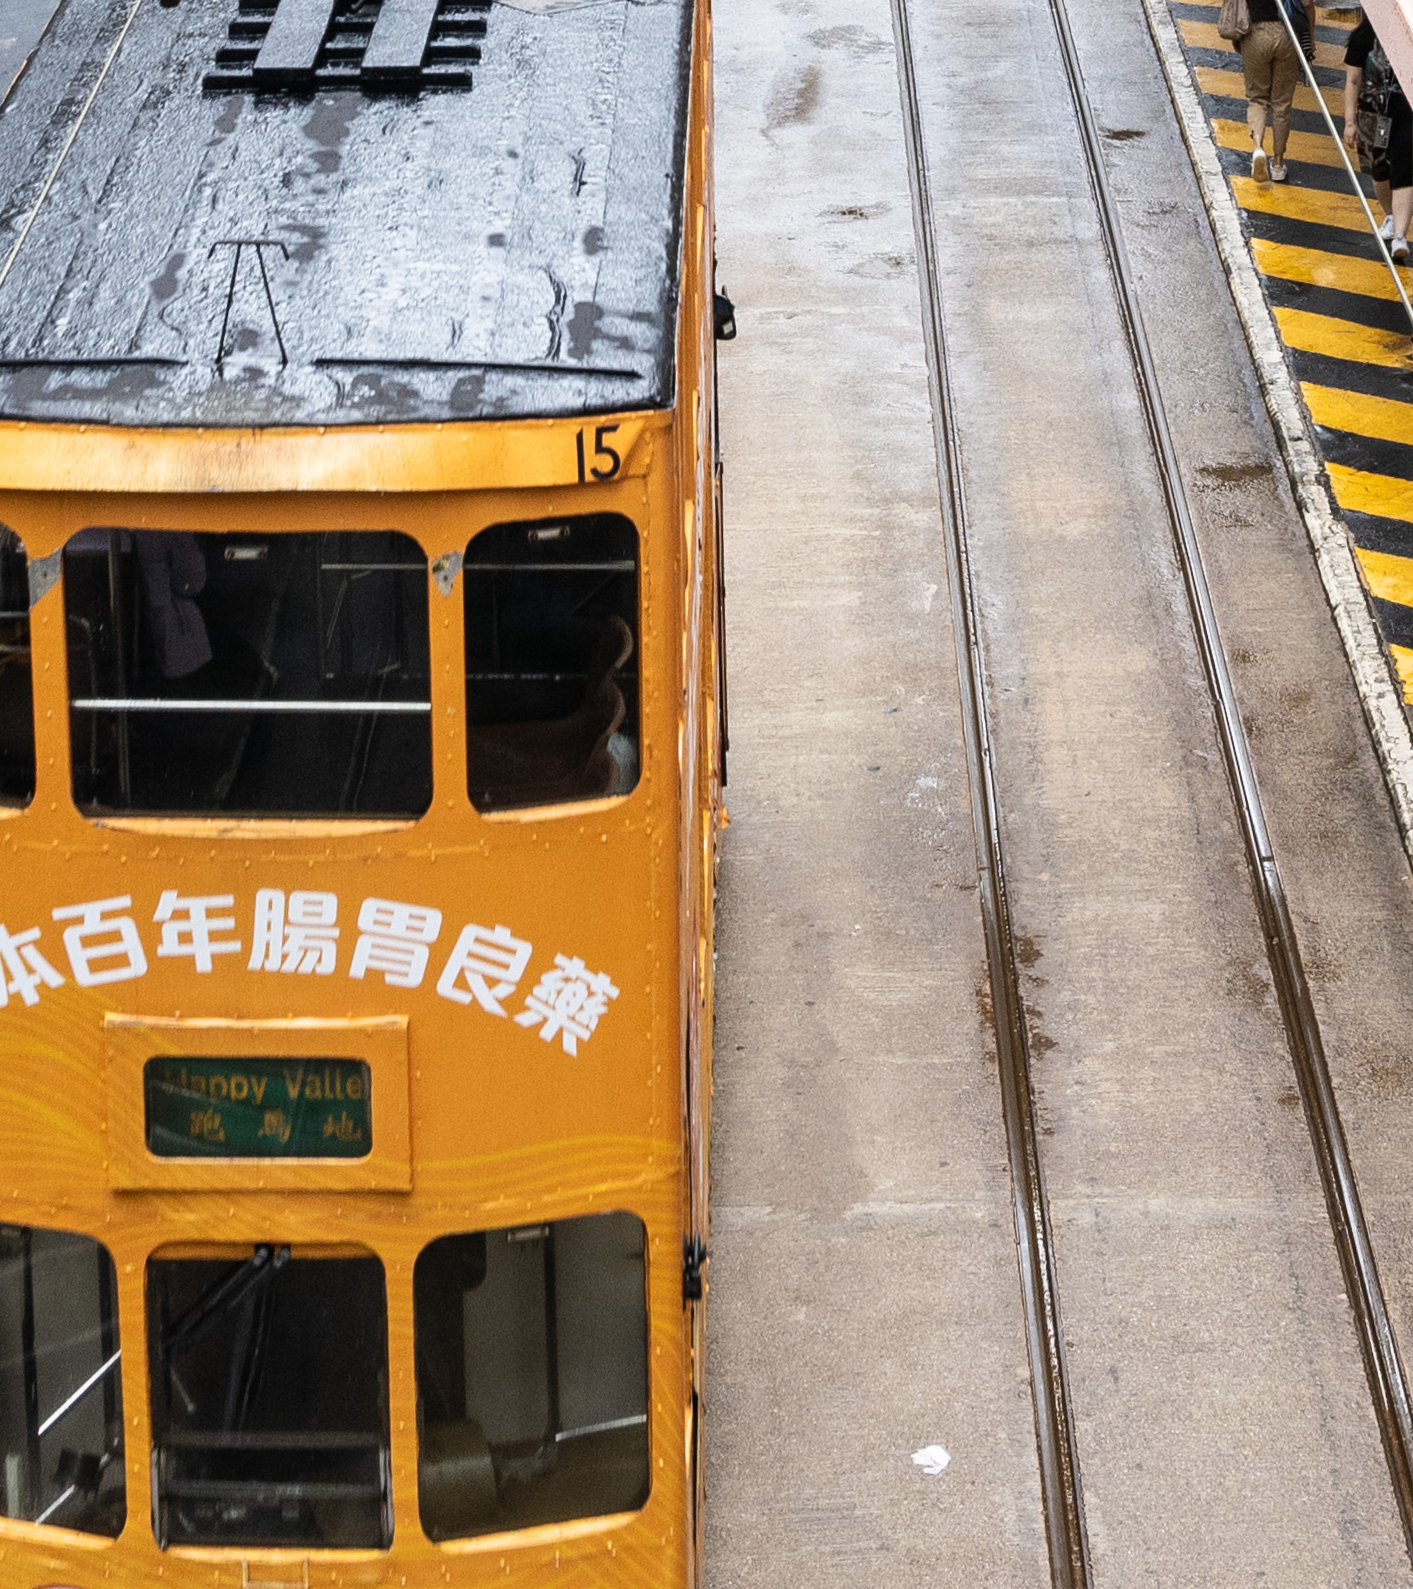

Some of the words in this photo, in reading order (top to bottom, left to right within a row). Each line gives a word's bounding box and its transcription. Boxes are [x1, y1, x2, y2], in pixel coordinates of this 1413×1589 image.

[574, 424, 622, 483] 15
[164, 1068, 268, 1106] Happy
[284, 1068, 364, 1100] Valle
[189, 1106, 363, 1145] 跑馬地
